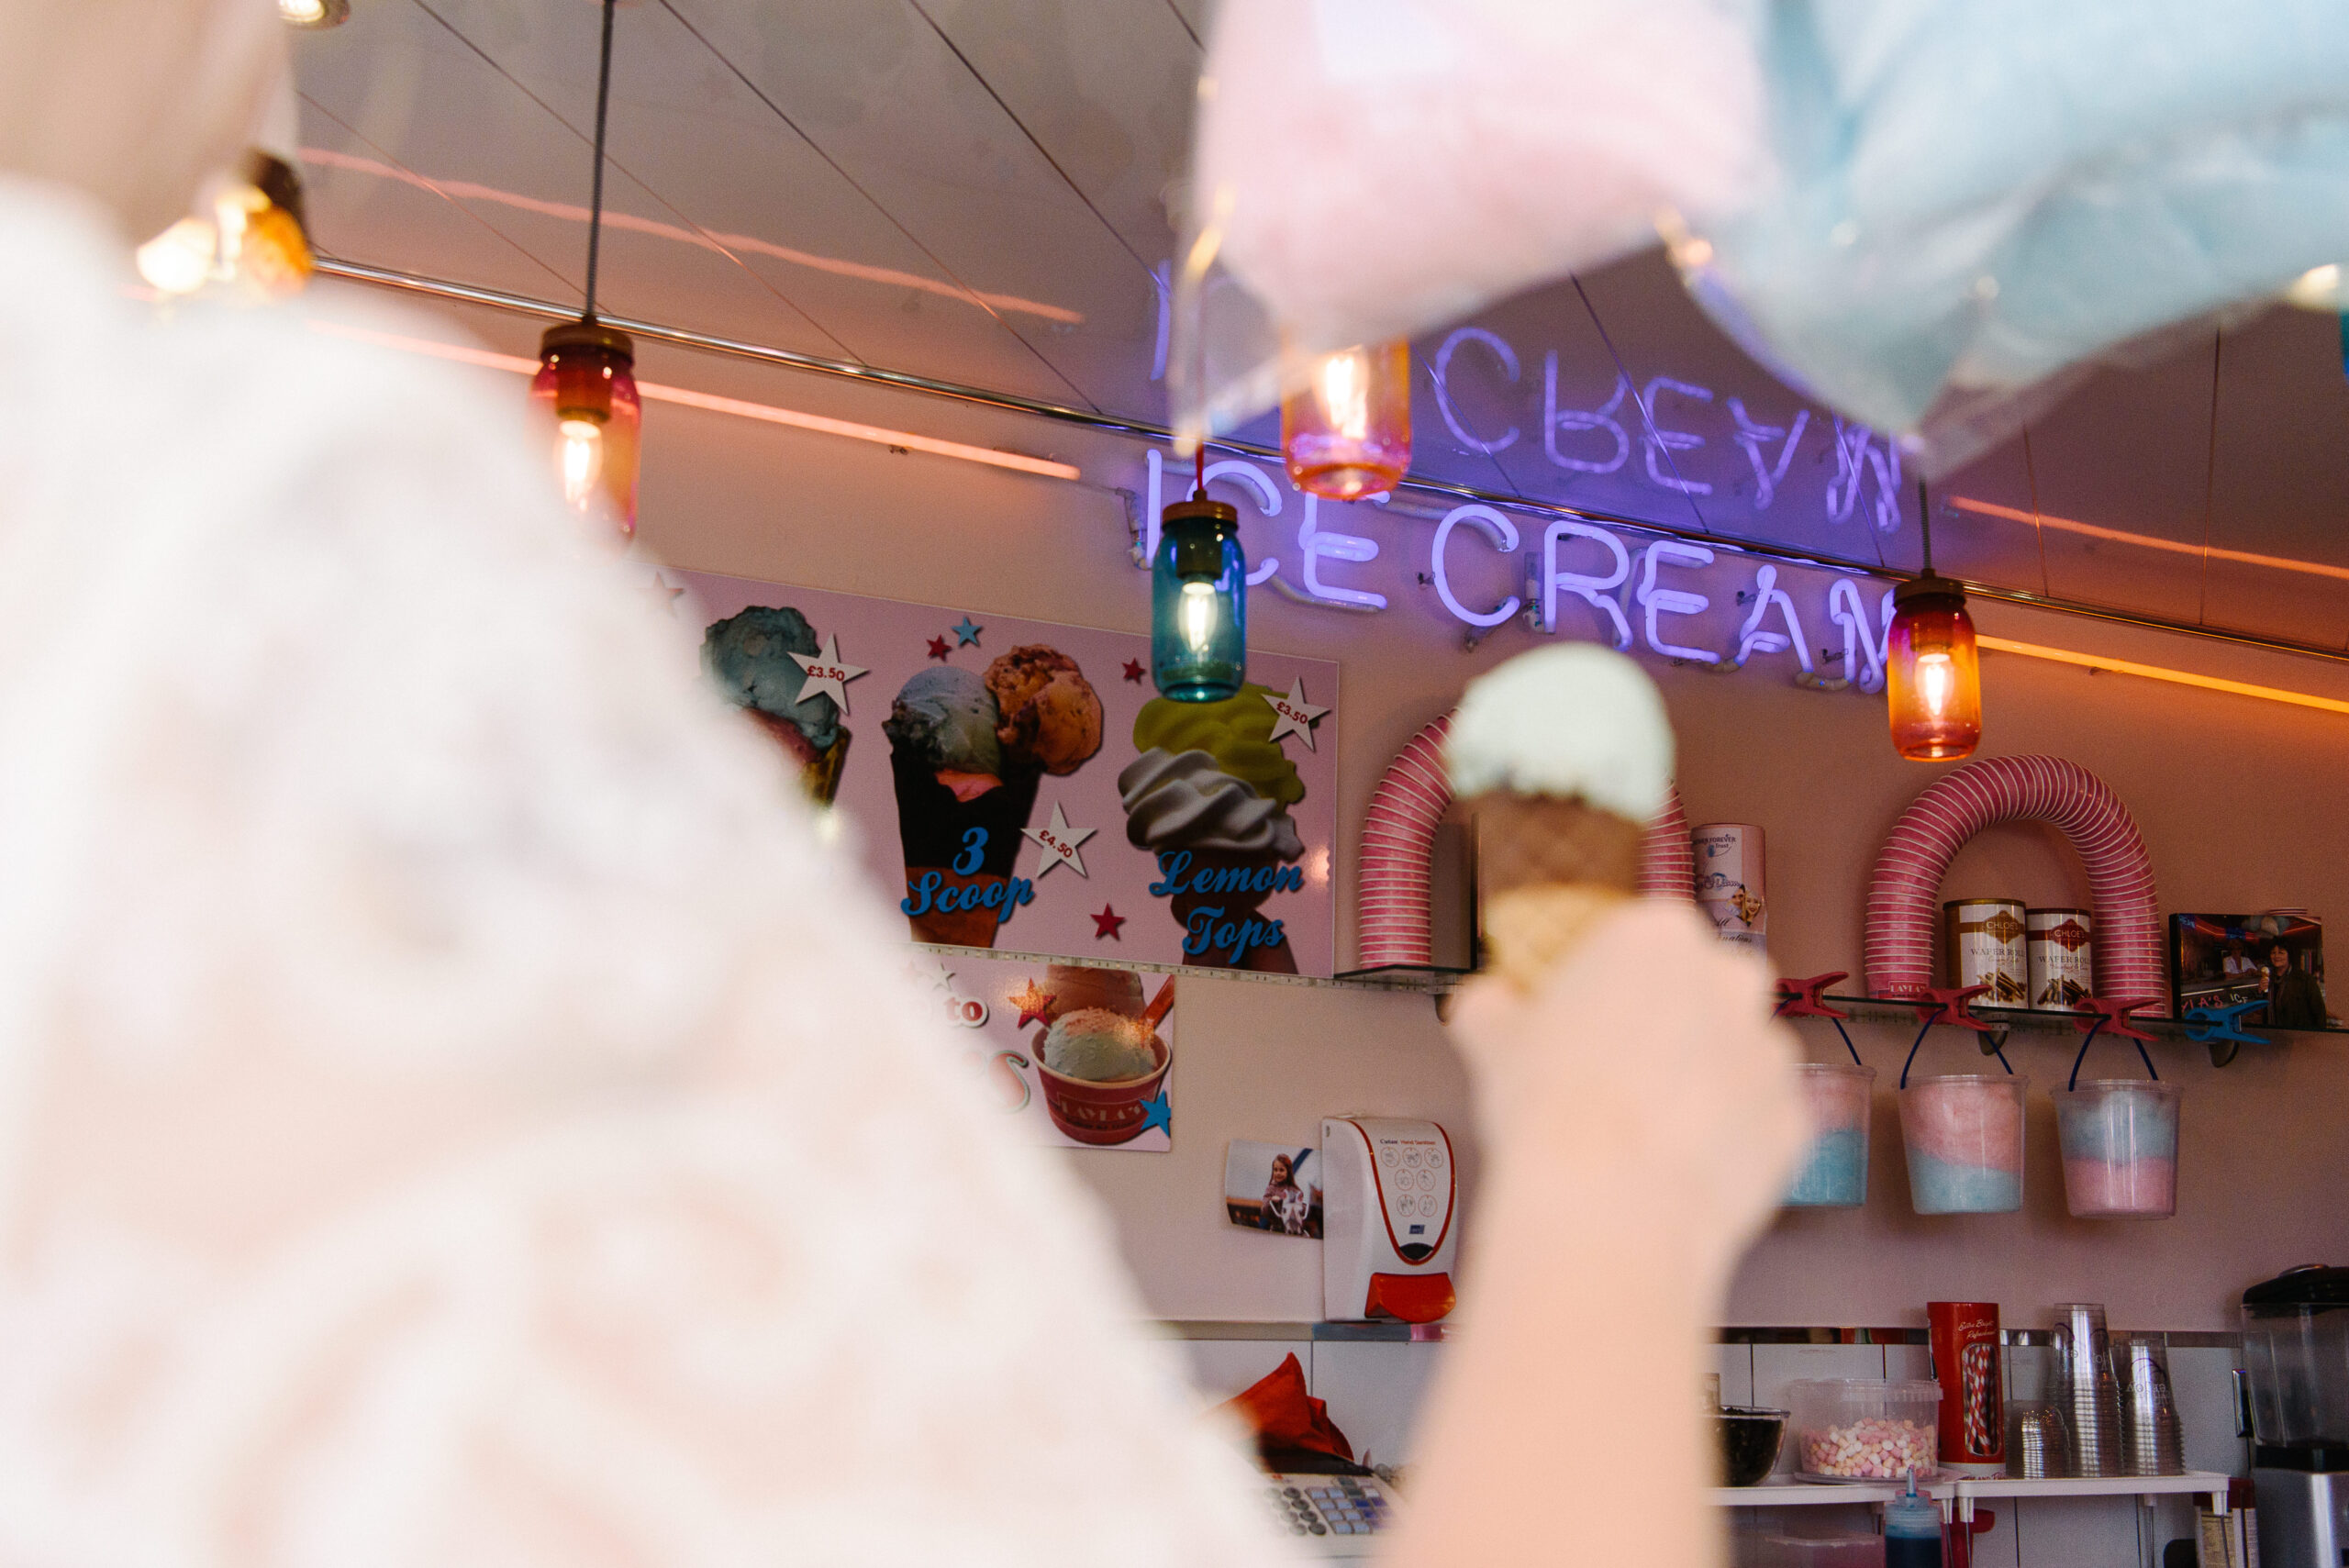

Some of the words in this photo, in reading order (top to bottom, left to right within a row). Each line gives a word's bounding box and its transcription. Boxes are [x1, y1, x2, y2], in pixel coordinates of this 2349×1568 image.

[1146, 449, 1388, 610] ICE
[1431, 504, 1899, 695] CREAM
[807, 665, 845, 682] £3.50
[1276, 701, 1308, 725] £3.50
[952, 826, 989, 875] 3
[1038, 828, 1073, 859] £4.50
[1148, 850, 1305, 895] Lemon
[900, 871, 1035, 923] Scoop
[1182, 906, 1285, 964] Tops
[1970, 948, 2006, 956] WAFER
[2038, 955, 2073, 963] WAFER
